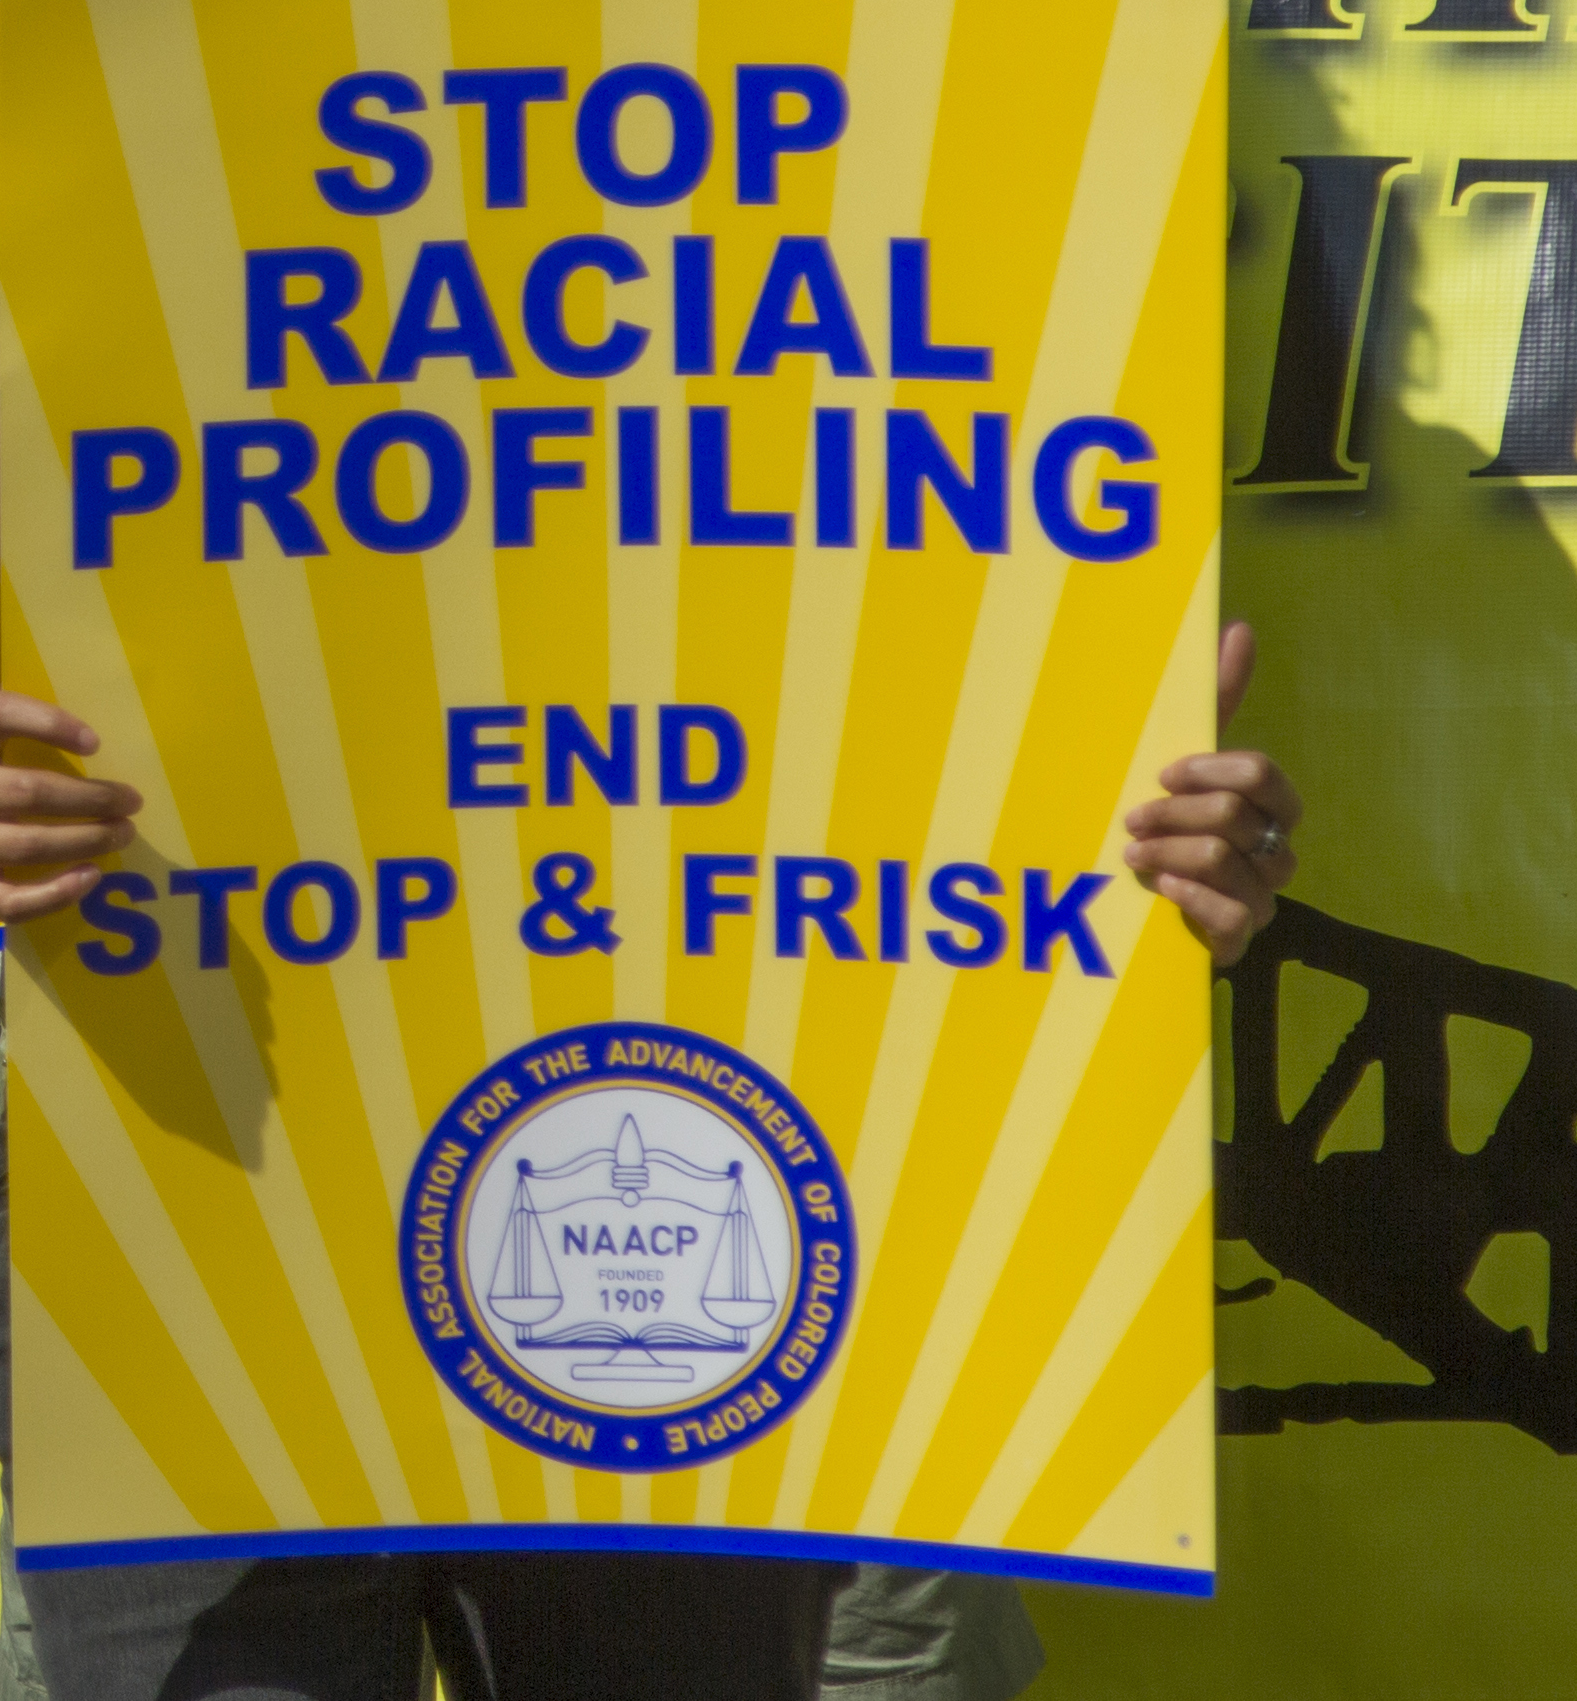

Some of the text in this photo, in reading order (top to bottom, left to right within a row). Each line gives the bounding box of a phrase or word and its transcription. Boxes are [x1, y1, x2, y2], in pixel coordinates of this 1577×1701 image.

[315, 62, 849, 217] STOP
[244, 234, 993, 389] RACIAL
[70, 405, 1160, 570] PROFILING
[446, 703, 748, 809] END
[76, 851, 1114, 979] STOP & FRISK
[418, 1039, 840, 1454] NATIONAL ASSOCIATION FOR THE ADVANCEMENT OF COLORED PEOPLE
[563, 1225, 699, 1257] NAACP
[598, 1269, 664, 1282] FOUNDED
[598, 1289, 665, 1313] 1909
